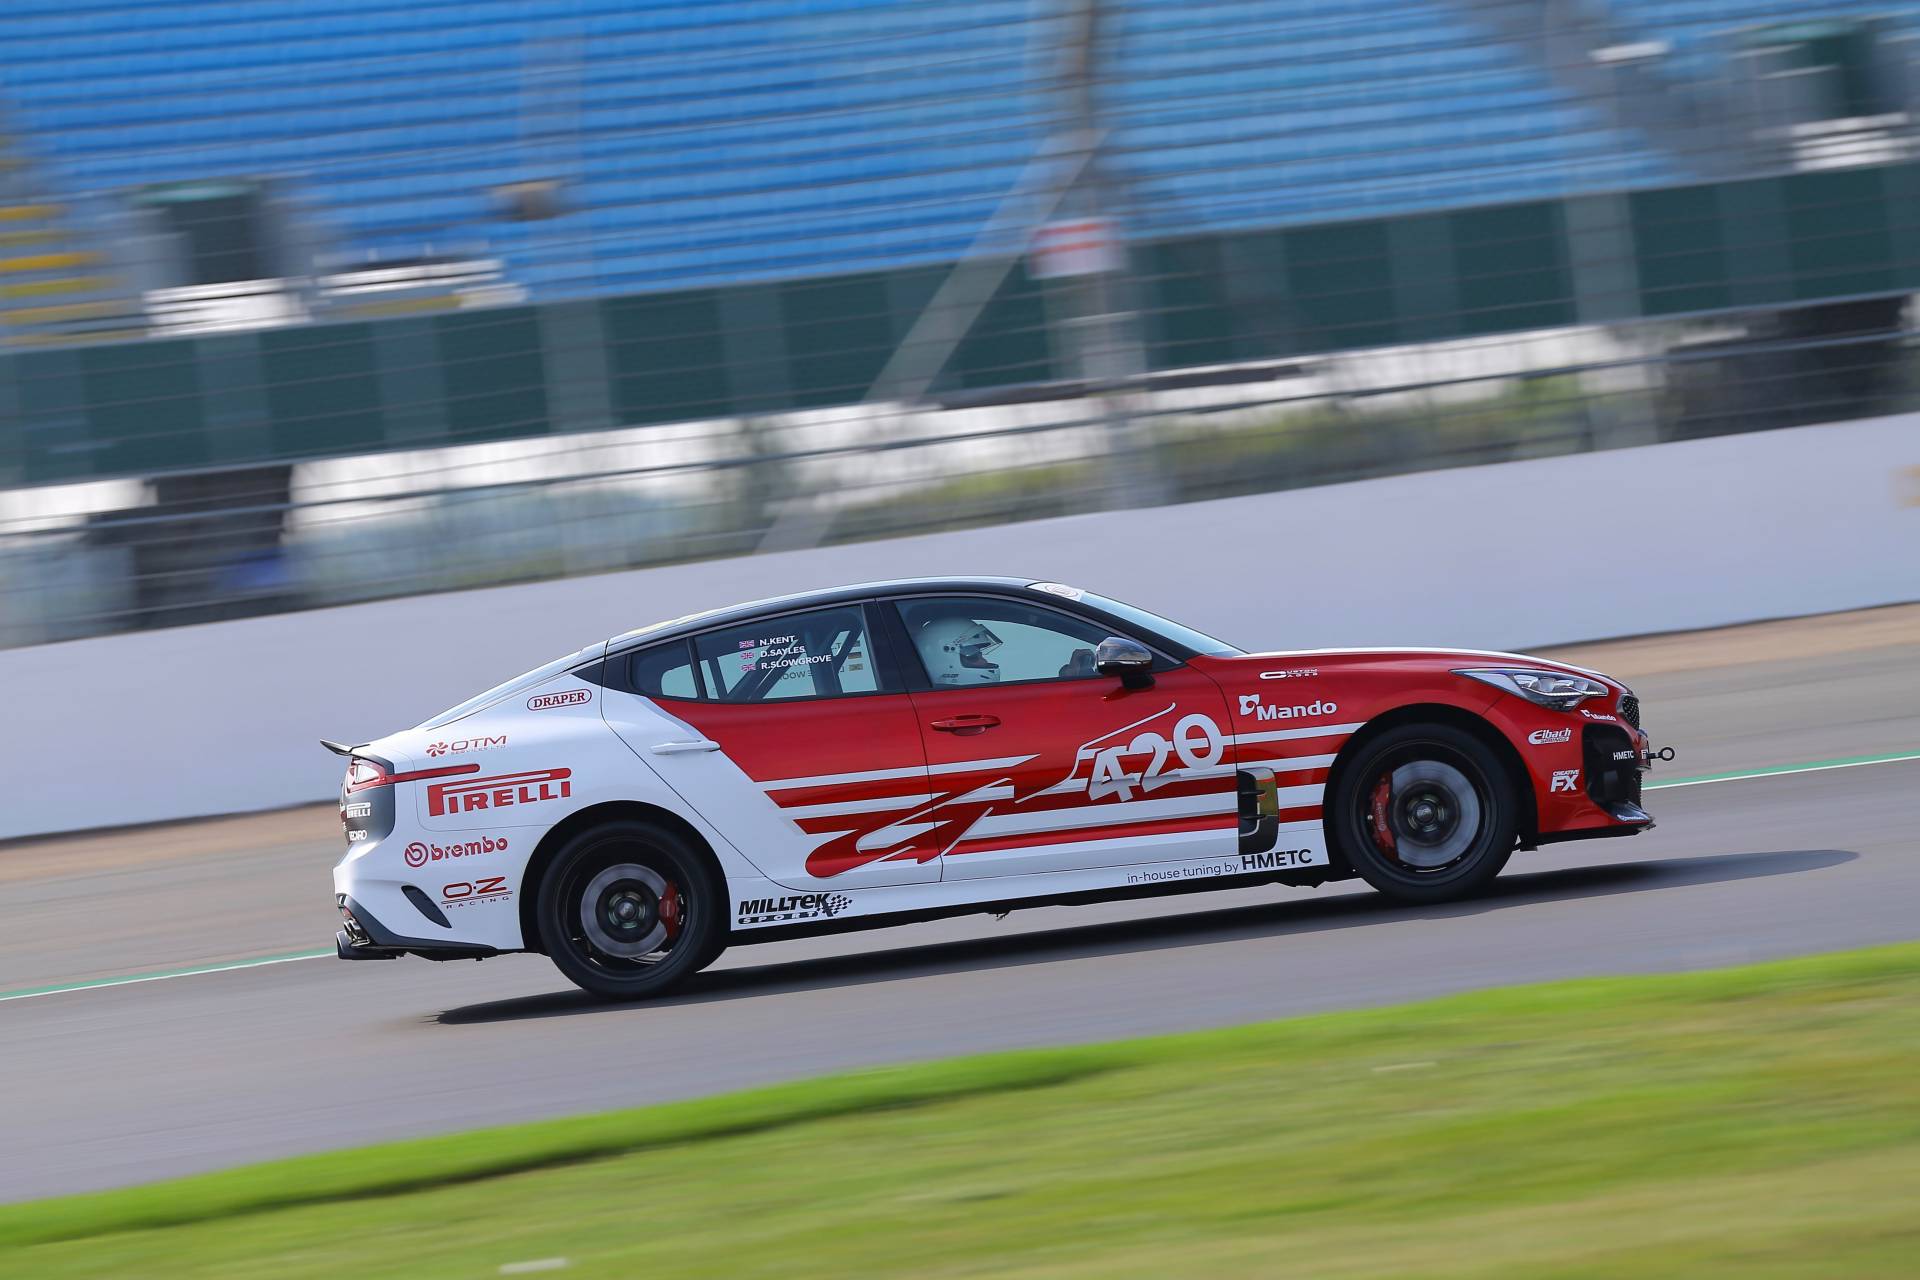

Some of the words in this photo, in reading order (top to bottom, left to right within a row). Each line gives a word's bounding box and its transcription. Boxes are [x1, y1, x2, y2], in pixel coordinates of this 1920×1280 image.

[760, 635, 795, 646] N.KENT
[760, 646, 805, 658] D.SAYLES
[761, 655, 832, 669] R.SLOWGROVE
[533, 692, 585, 708] DRAPER
[1257, 700, 1337, 721] Mando
[451, 735, 507, 751] OTM
[1088, 713, 1224, 802] 420
[1613, 750, 1634, 760] HMETC
[1551, 775, 1578, 792] FX
[427, 767, 571, 817] PIRELLI
[431, 836, 508, 861] brembo
[1128, 870, 1180, 883] in-house
[1183, 864, 1221, 877] tuning
[1225, 862, 1239, 874] by
[1242, 849, 1313, 870] HMETC
[446, 896, 509, 909] RACING
[742, 911, 816, 924] SPORT
